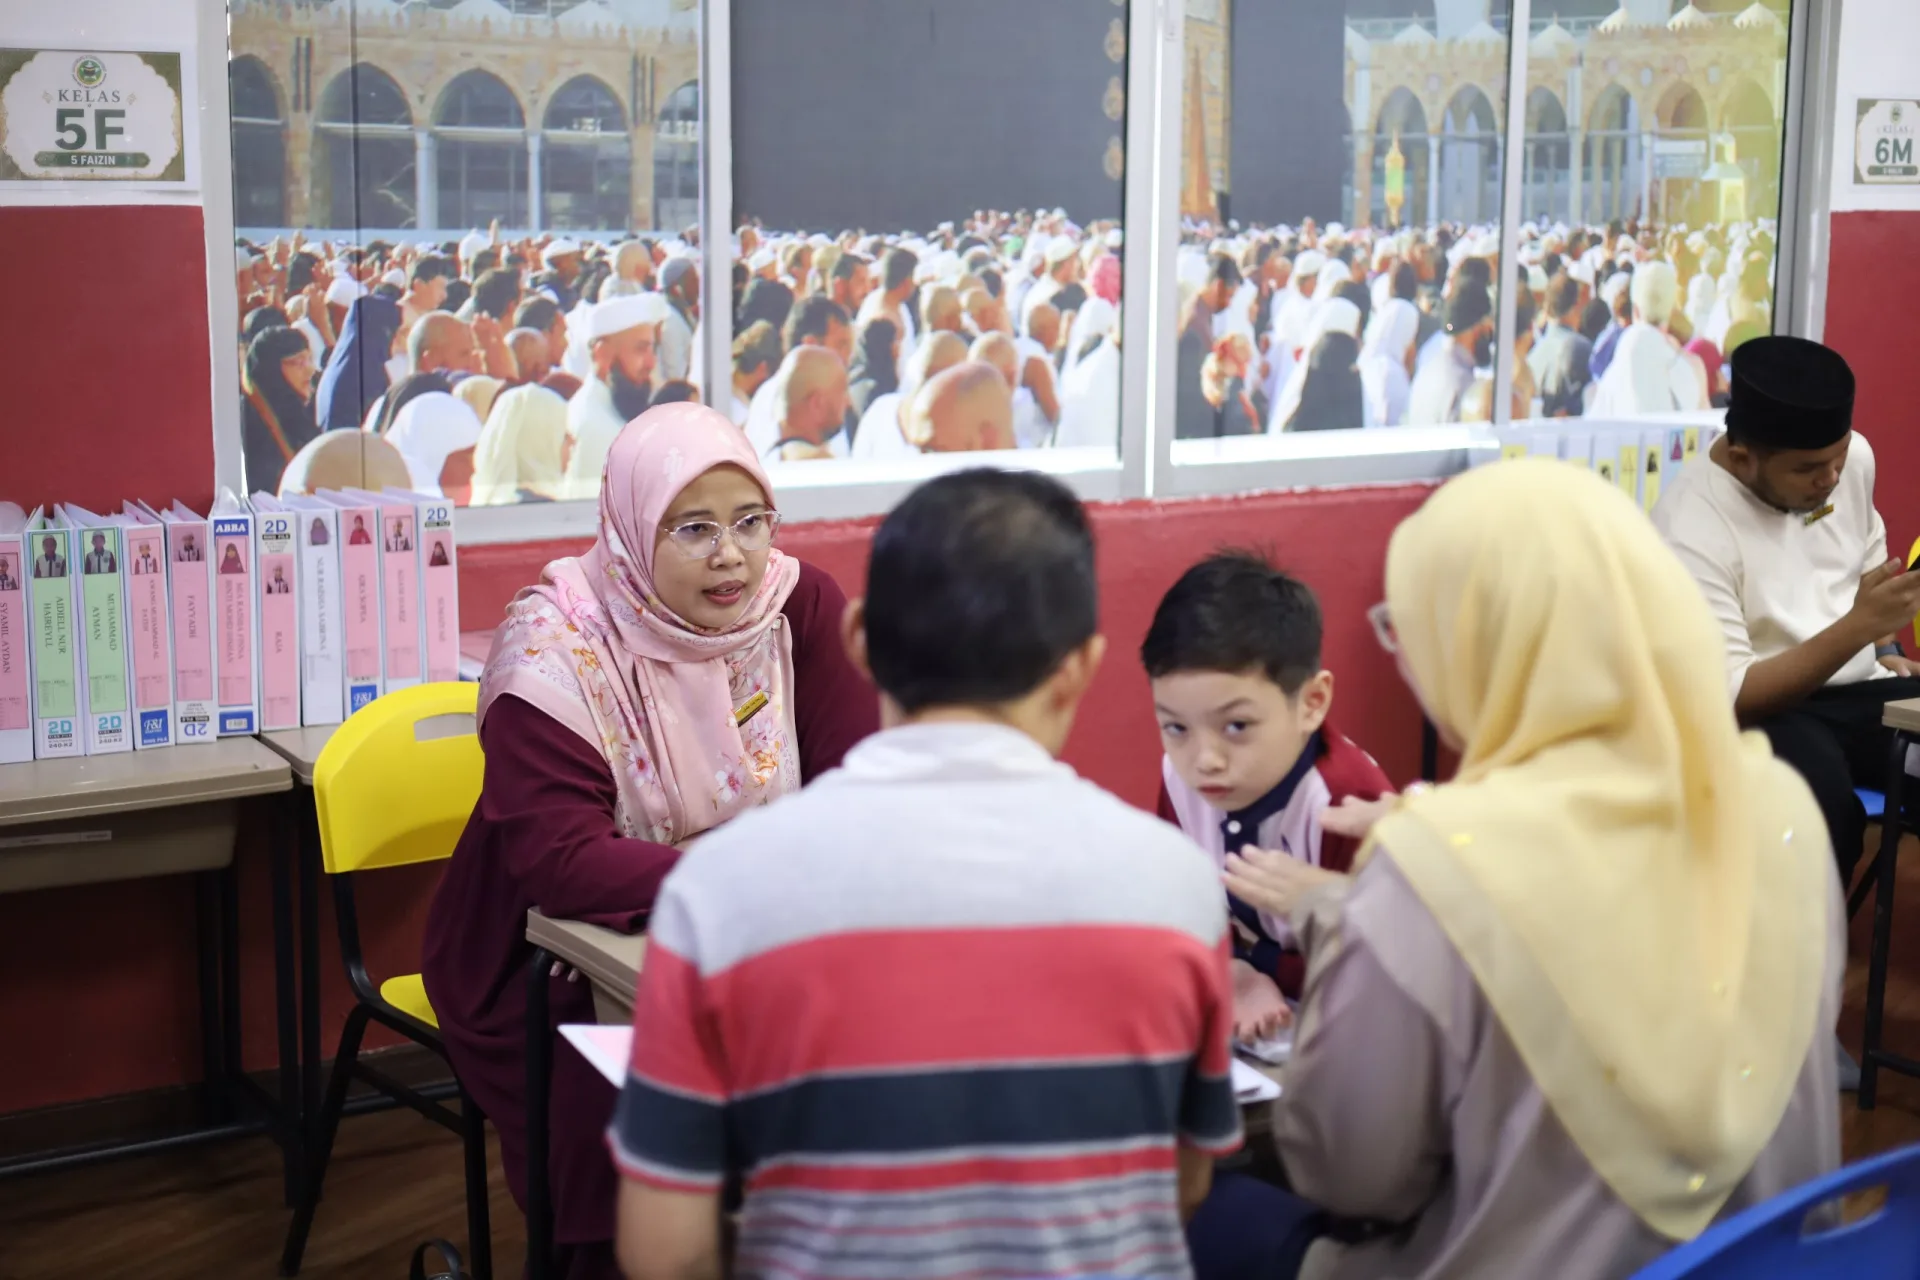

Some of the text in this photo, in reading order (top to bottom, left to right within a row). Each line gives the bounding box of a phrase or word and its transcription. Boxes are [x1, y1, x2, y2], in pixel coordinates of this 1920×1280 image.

[58, 89, 121, 103] KELAS
[55, 108, 126, 151] 5F
[70, 155, 116, 165] 5 FAIZIN
[1875, 137, 1913, 164] 6M
[427, 507, 448, 521] 2D
[215, 523, 246, 533] ABBA
[264, 520, 288, 533] 2D
[55, 596, 67, 654] AIDIELL NUR
[91, 606, 102, 641] AYMAN
[107, 593, 118, 651] MUHAMMAD
[186, 595, 197, 639] FAYYADH
[0, 602, 12, 674] SYAMIL AYDAN
[150, 606, 159, 650] MUHAMMAD
[48, 720, 73, 734] 2D
[98, 716, 122, 730] 2D
[184, 723, 208, 737] 2D
